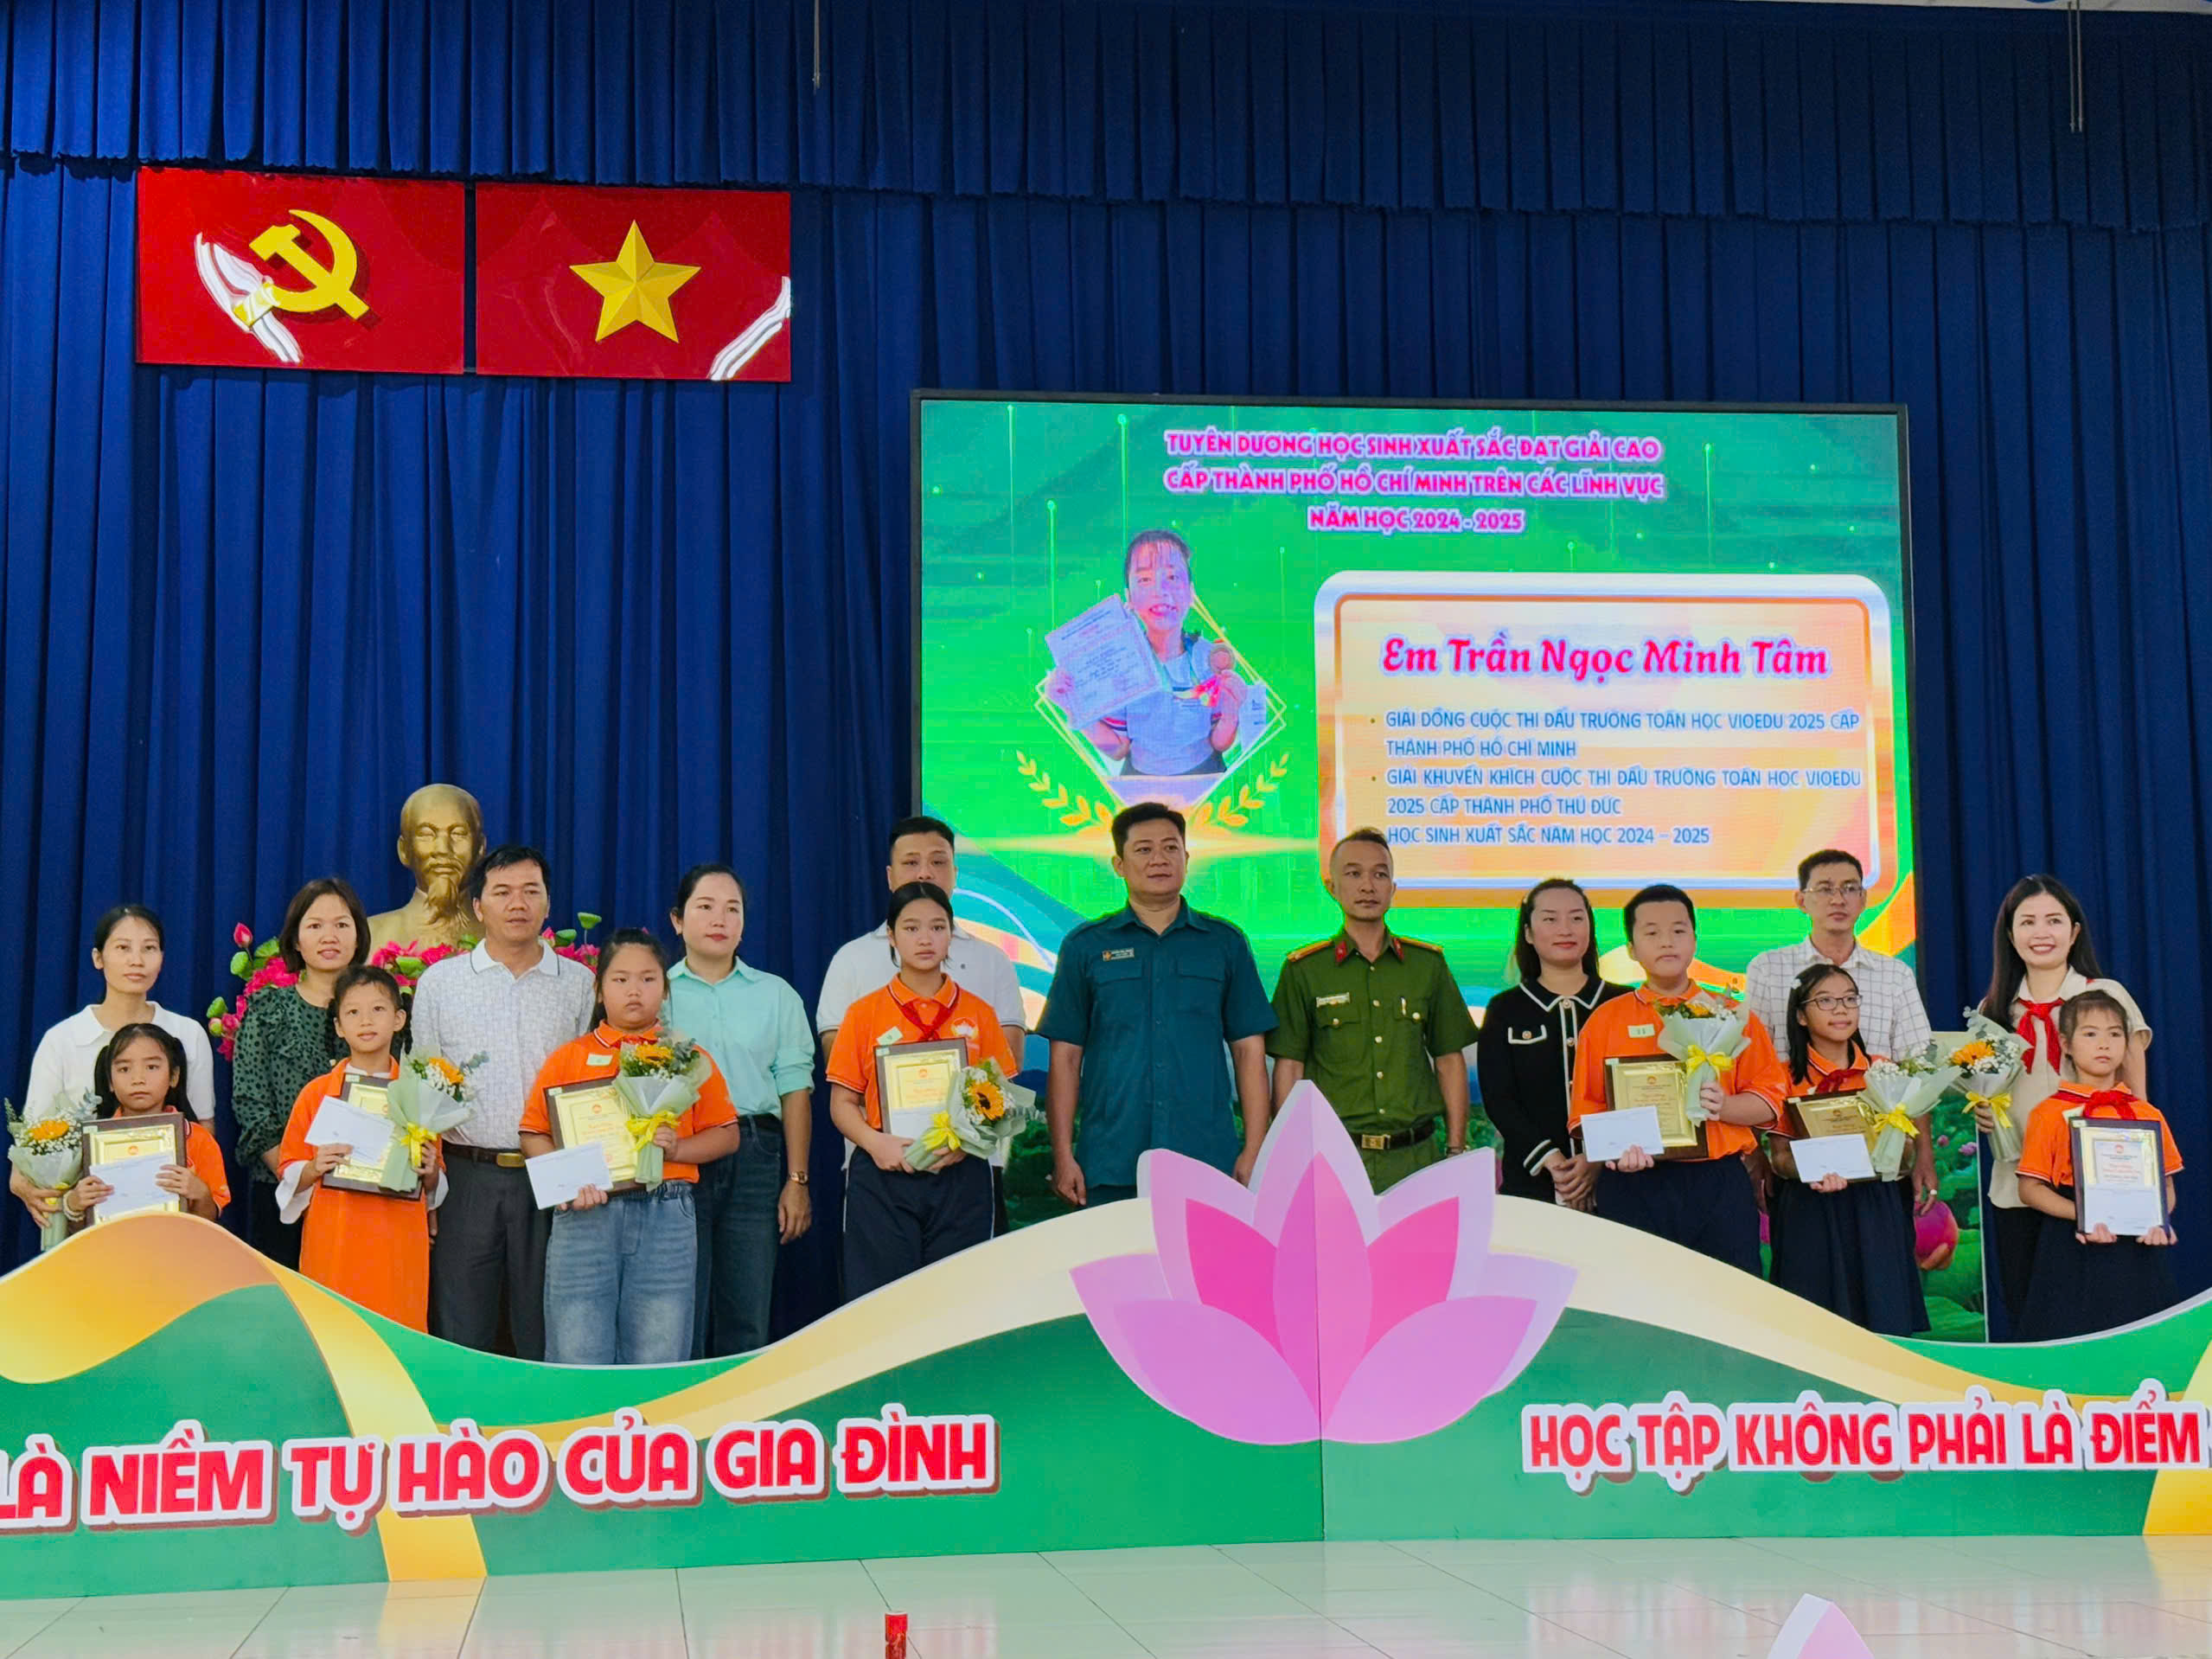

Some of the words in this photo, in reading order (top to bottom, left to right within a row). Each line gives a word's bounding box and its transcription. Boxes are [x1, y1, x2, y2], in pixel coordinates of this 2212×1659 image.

[1167, 428, 1231, 452] TUYÊN
[1237, 432, 1313, 454] DƯƠNG
[1320, 437, 1363, 460] HỌC
[1368, 438, 1411, 456] SINH
[1416, 429, 1472, 456] XUẤT
[1477, 427, 1513, 457] SẮC
[1519, 439, 1559, 463] ĐẠT
[1564, 432, 1610, 458] GIẢI
[1614, 441, 1660, 459] CAO
[1167, 464, 1208, 490] CẤP
[1213, 465, 1284, 491] THÀNH
[1290, 464, 1335, 491] PHỐ
[1341, 464, 1373, 492] HỒ
[1378, 468, 1410, 492] CHÍ
[1415, 475, 1467, 493] MINH
[1472, 469, 1523, 494] TRÊN
[1528, 470, 1567, 495] CÁC
[1572, 471, 1618, 496] LĨNH
[1622, 477, 1663, 501] VỰC
[1309, 504, 1359, 528] NĂM
[1365, 511, 1410, 535] HỌC
[1413, 512, 1461, 529] 2024
[1474, 514, 1523, 530] 2025
[1384, 637, 1437, 672] Em
[1448, 632, 1531, 673] Trần
[1542, 638, 1633, 683] Ngọc
[1644, 640, 1740, 675] Minh
[1752, 639, 1828, 675] Tâm
[1517, 712, 1539, 728] THI
[1728, 712, 1784, 729] VIOEDU
[1788, 714, 1826, 729] 2025
[1538, 740, 1577, 757] MINH
[1588, 770, 1611, 785] THI
[1806, 771, 1862, 786] VIOEDU
[1388, 797, 1425, 814] 2025
[1388, 827, 1421, 846] HỌC
[1425, 827, 1460, 844] SINH
[1581, 828, 1612, 847] HỌC
[1617, 828, 1655, 845] 2024
[1673, 828, 1710, 845] 2025
[1531, 1412, 1624, 1480] HỌC
[1637, 1403, 1721, 1479] TẬP
[1736, 1402, 1893, 1466] KHÔNG
[1908, 1394, 2007, 1465] PHẢI
[2023, 1402, 2075, 1464] LÀ
[2089, 1388, 2202, 1464] ĐIỂM
[89, 1428, 264, 1516] NIỀM
[291, 1443, 376, 1521] TỰ
[398, 1426, 541, 1503] HÀO
[564, 1414, 690, 1496] CỦA
[713, 1429, 816, 1490] GIA
[841, 1412, 987, 1485] ĐÌNH
